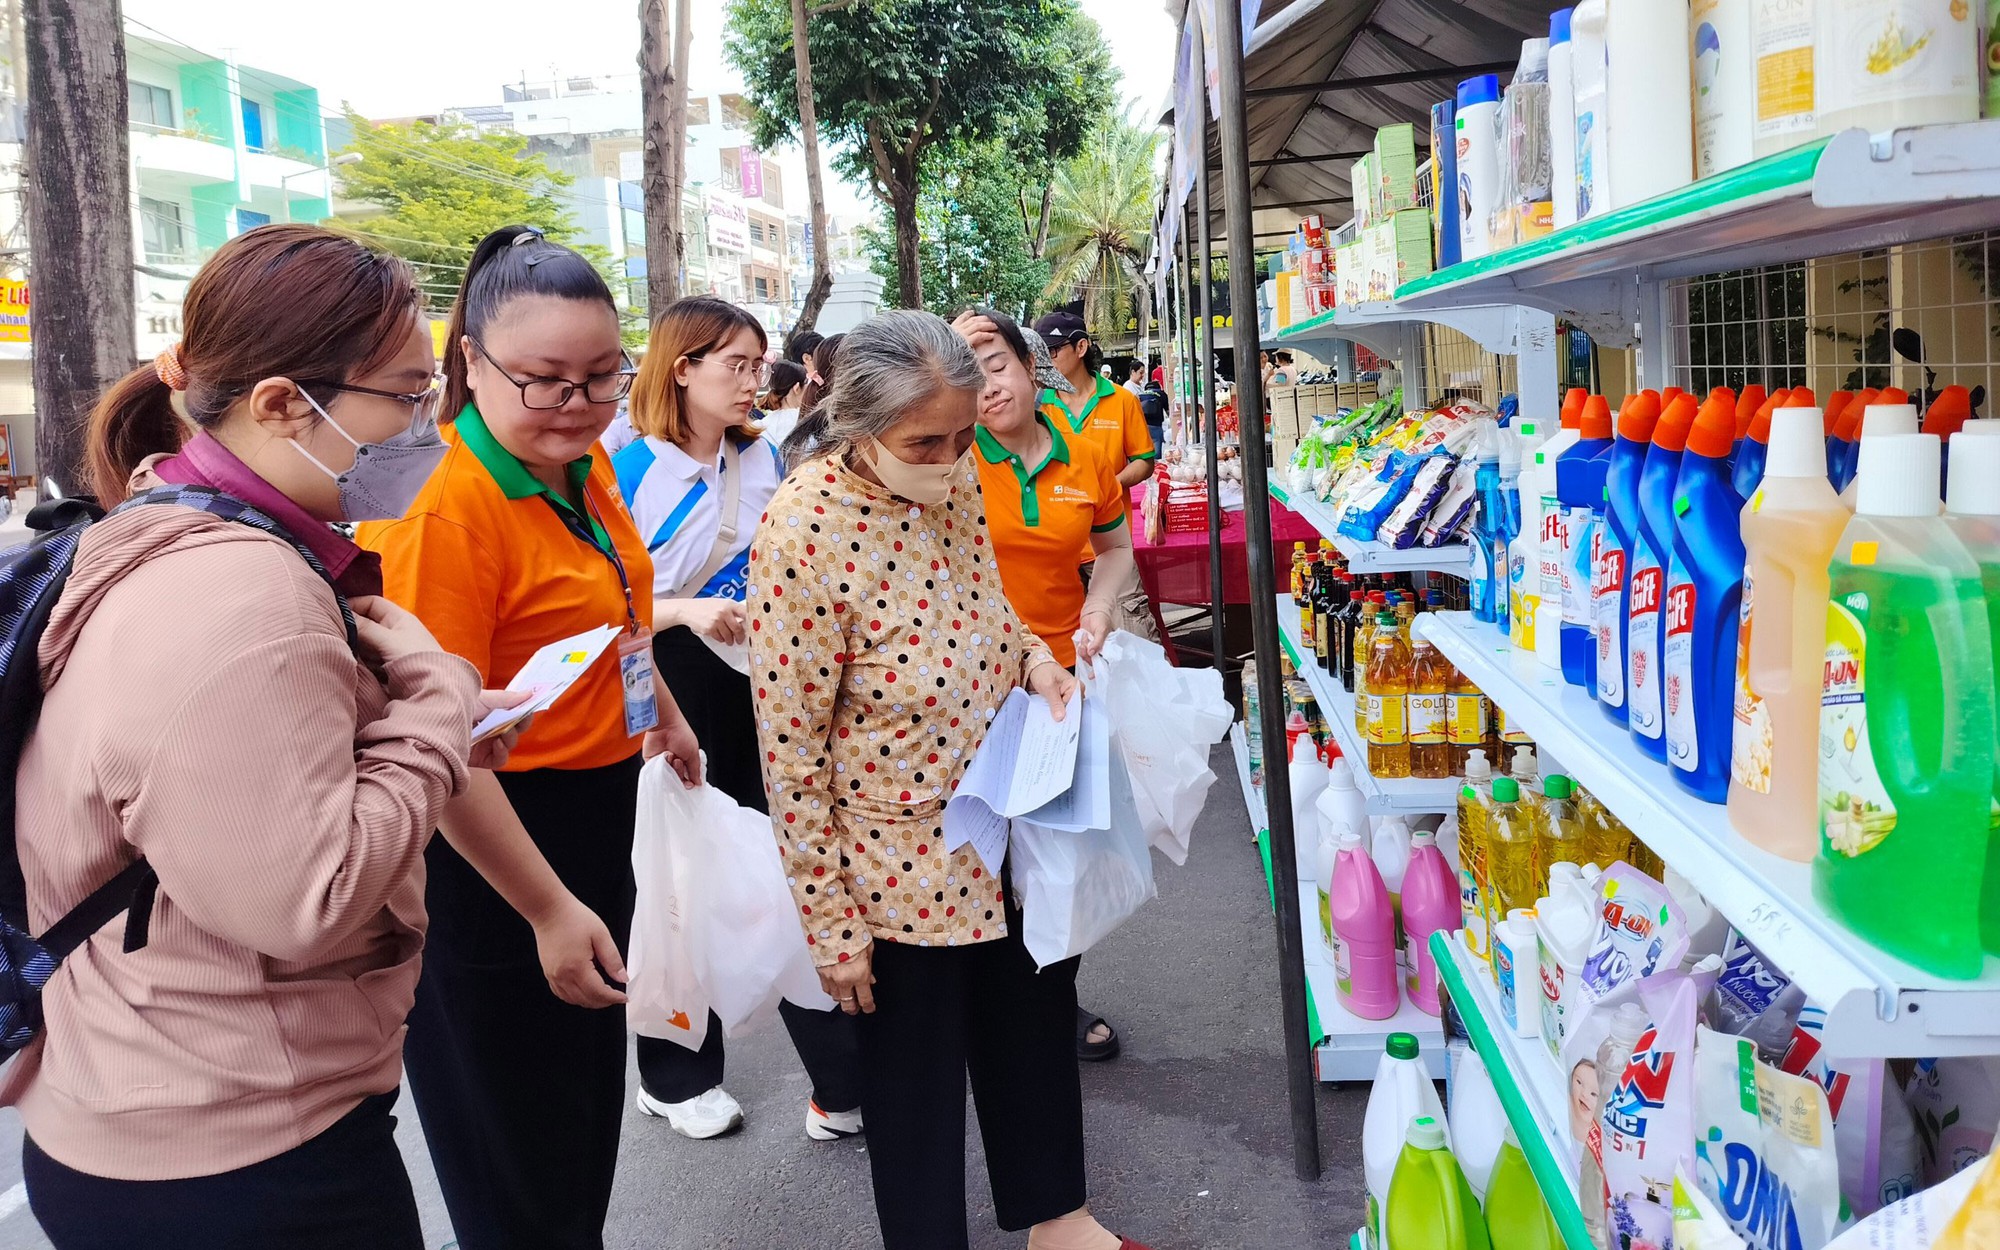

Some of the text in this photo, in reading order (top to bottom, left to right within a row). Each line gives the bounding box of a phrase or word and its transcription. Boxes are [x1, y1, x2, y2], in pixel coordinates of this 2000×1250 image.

[1600, 554, 1620, 590] Gift
[1631, 571, 1656, 613] Gift
[1636, 1140, 1647, 1160] 1
